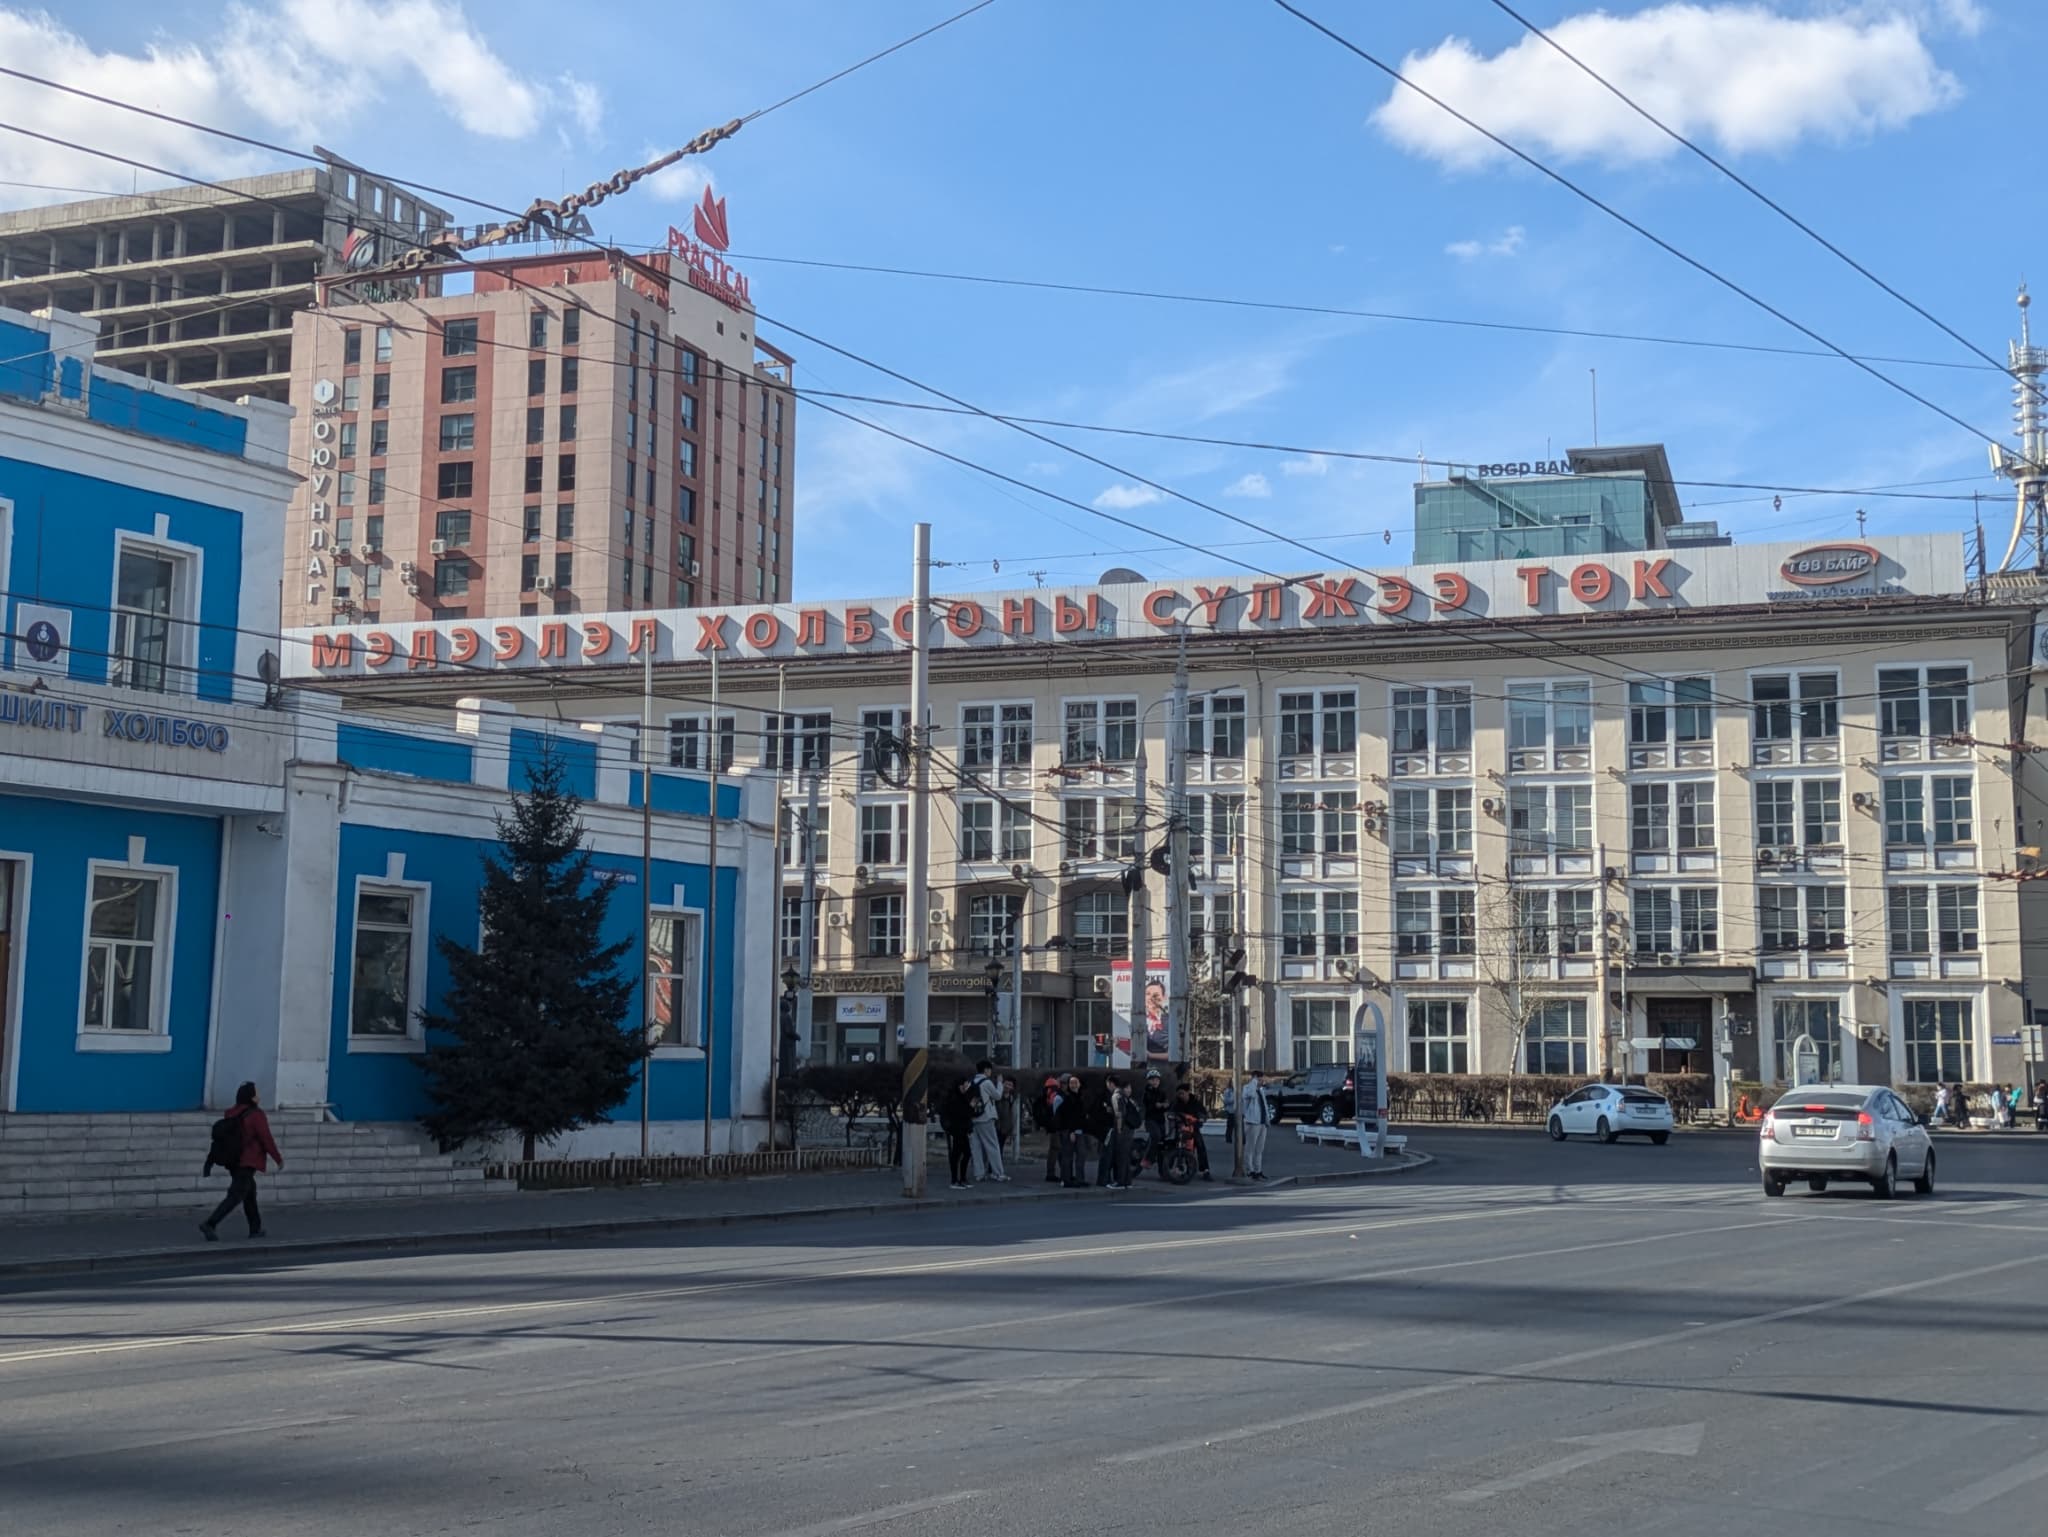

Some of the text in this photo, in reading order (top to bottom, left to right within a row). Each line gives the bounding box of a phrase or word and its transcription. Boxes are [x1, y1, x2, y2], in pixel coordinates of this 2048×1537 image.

[668, 225, 751, 304] PRACTICAL
[1478, 462, 1530, 477] BOGD
[308, 421, 330, 603] ОЮУНЛАГ
[1825, 553, 1868, 571] БАЙР
[312, 618, 657, 669] МЭДЭЭЛЭЛ
[1143, 572, 1470, 626] СҮЛЖЭЭ
[1517, 558, 1674, 607] ТӨК
[107, 709, 230, 752] ХОЛБОО
